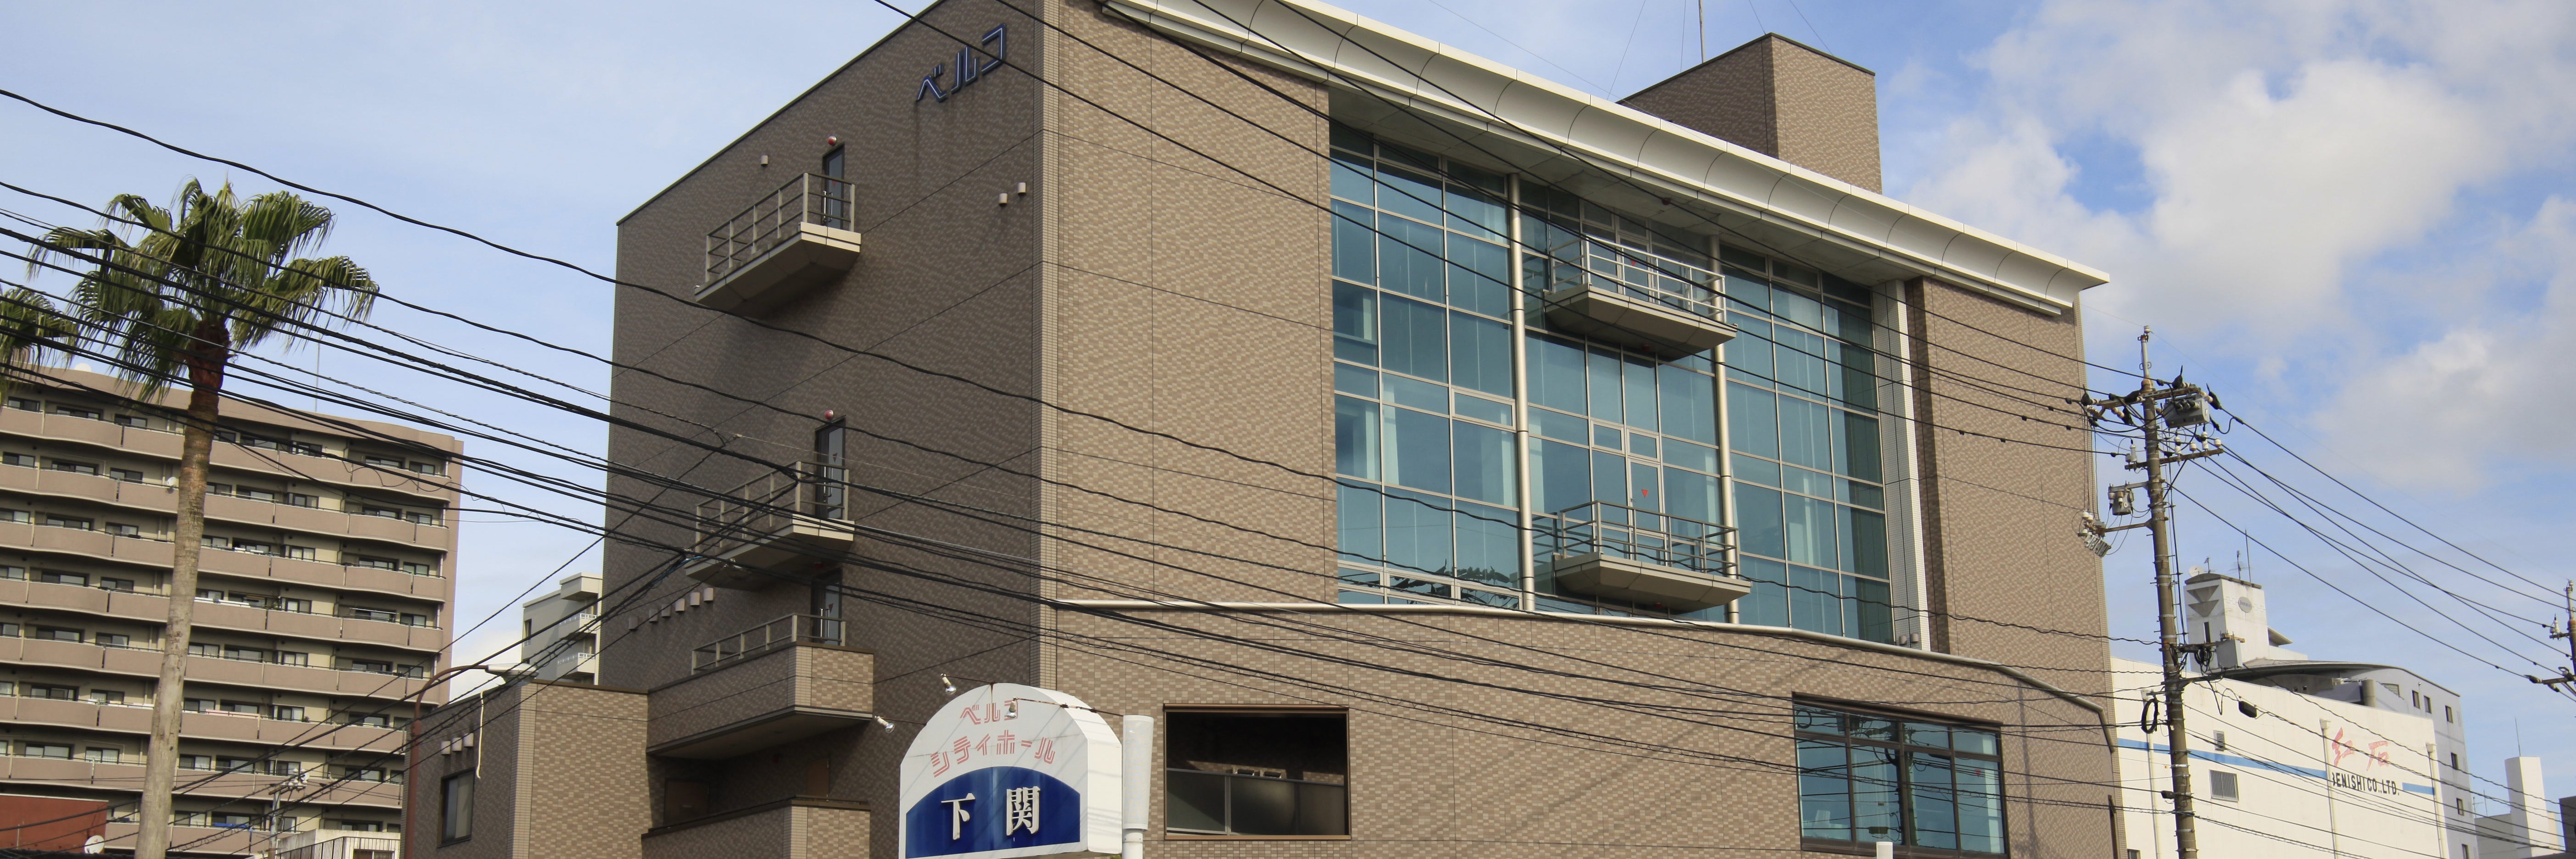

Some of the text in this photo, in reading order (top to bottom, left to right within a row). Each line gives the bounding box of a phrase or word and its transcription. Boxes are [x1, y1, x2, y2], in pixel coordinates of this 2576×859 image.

[917, 23, 1006, 102] ベルコ
[960, 699, 1018, 725] ベルコ
[930, 729, 1055, 778] シティホール
[941, 786, 1041, 840] 下関
